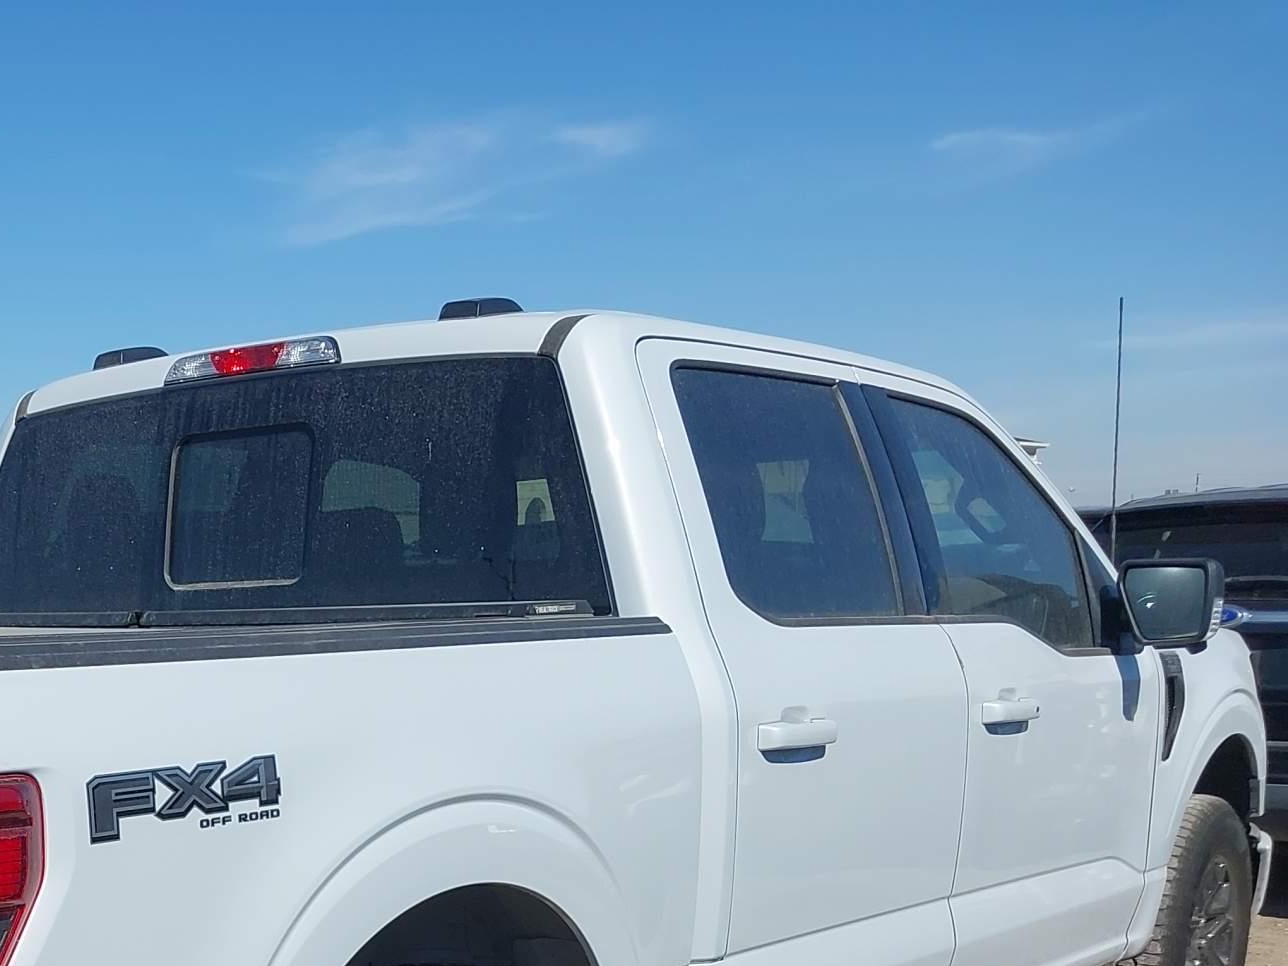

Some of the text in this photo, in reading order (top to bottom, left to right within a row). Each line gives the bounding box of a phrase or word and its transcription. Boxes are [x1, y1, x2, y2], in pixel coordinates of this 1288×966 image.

[86, 754, 281, 845] FX4
[200, 809, 280, 829] OFF ROAD
